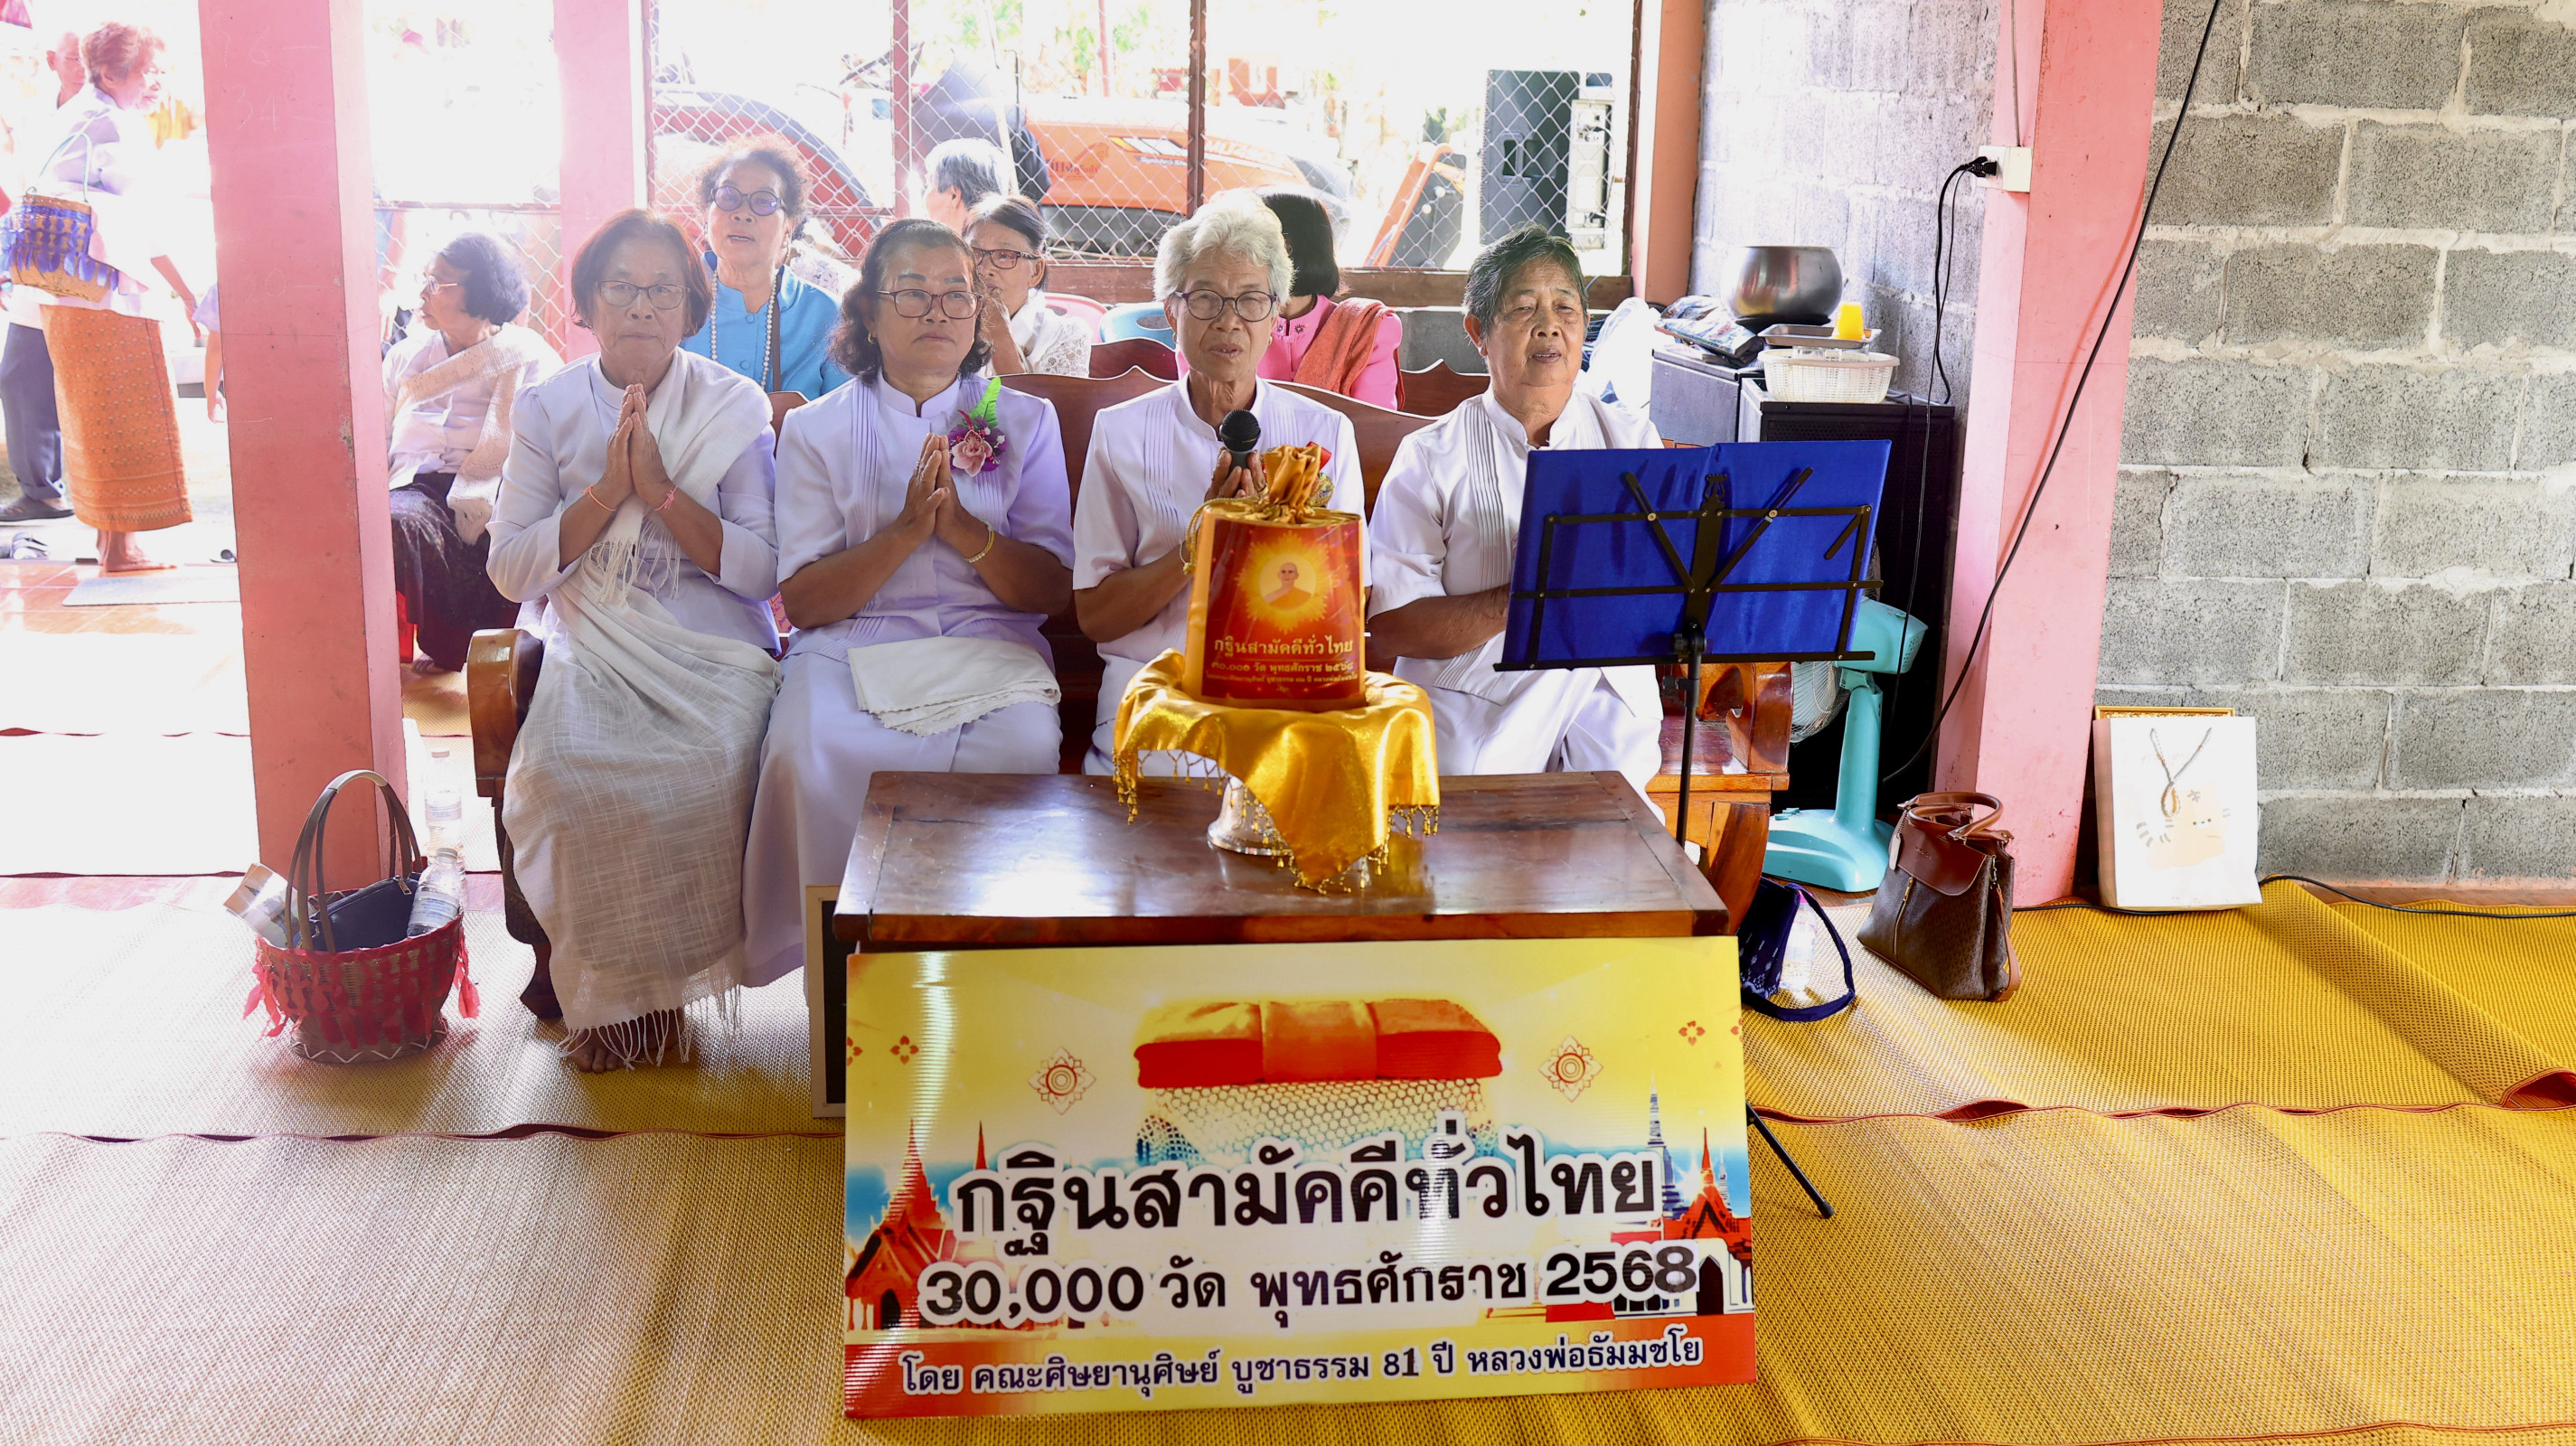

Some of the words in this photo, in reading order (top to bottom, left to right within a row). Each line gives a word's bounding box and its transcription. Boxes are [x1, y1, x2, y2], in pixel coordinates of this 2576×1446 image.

[1214, 634, 1354, 658] กฐินสามัคคีทั่วไทย
[956, 1119, 1655, 1257] กฐินสามัคคีทั่วไทย
[926, 1266, 1145, 1319] 30,000
[1159, 1254, 1227, 1309] วัด
[1250, 1250, 1528, 1329] พุทธศักราช
[1546, 1245, 1697, 1297] 2568
[902, 1355, 960, 1392] โดย
[974, 1347, 1222, 1398] คณะศิษยานุศิษย์
[1232, 1353, 1369, 1394] บูชาธรรม
[1383, 1347, 1420, 1377] 81
[1431, 1340, 1454, 1375] ปี
[1466, 1326, 1700, 1374] หลวงพ่อธัมมชโย
